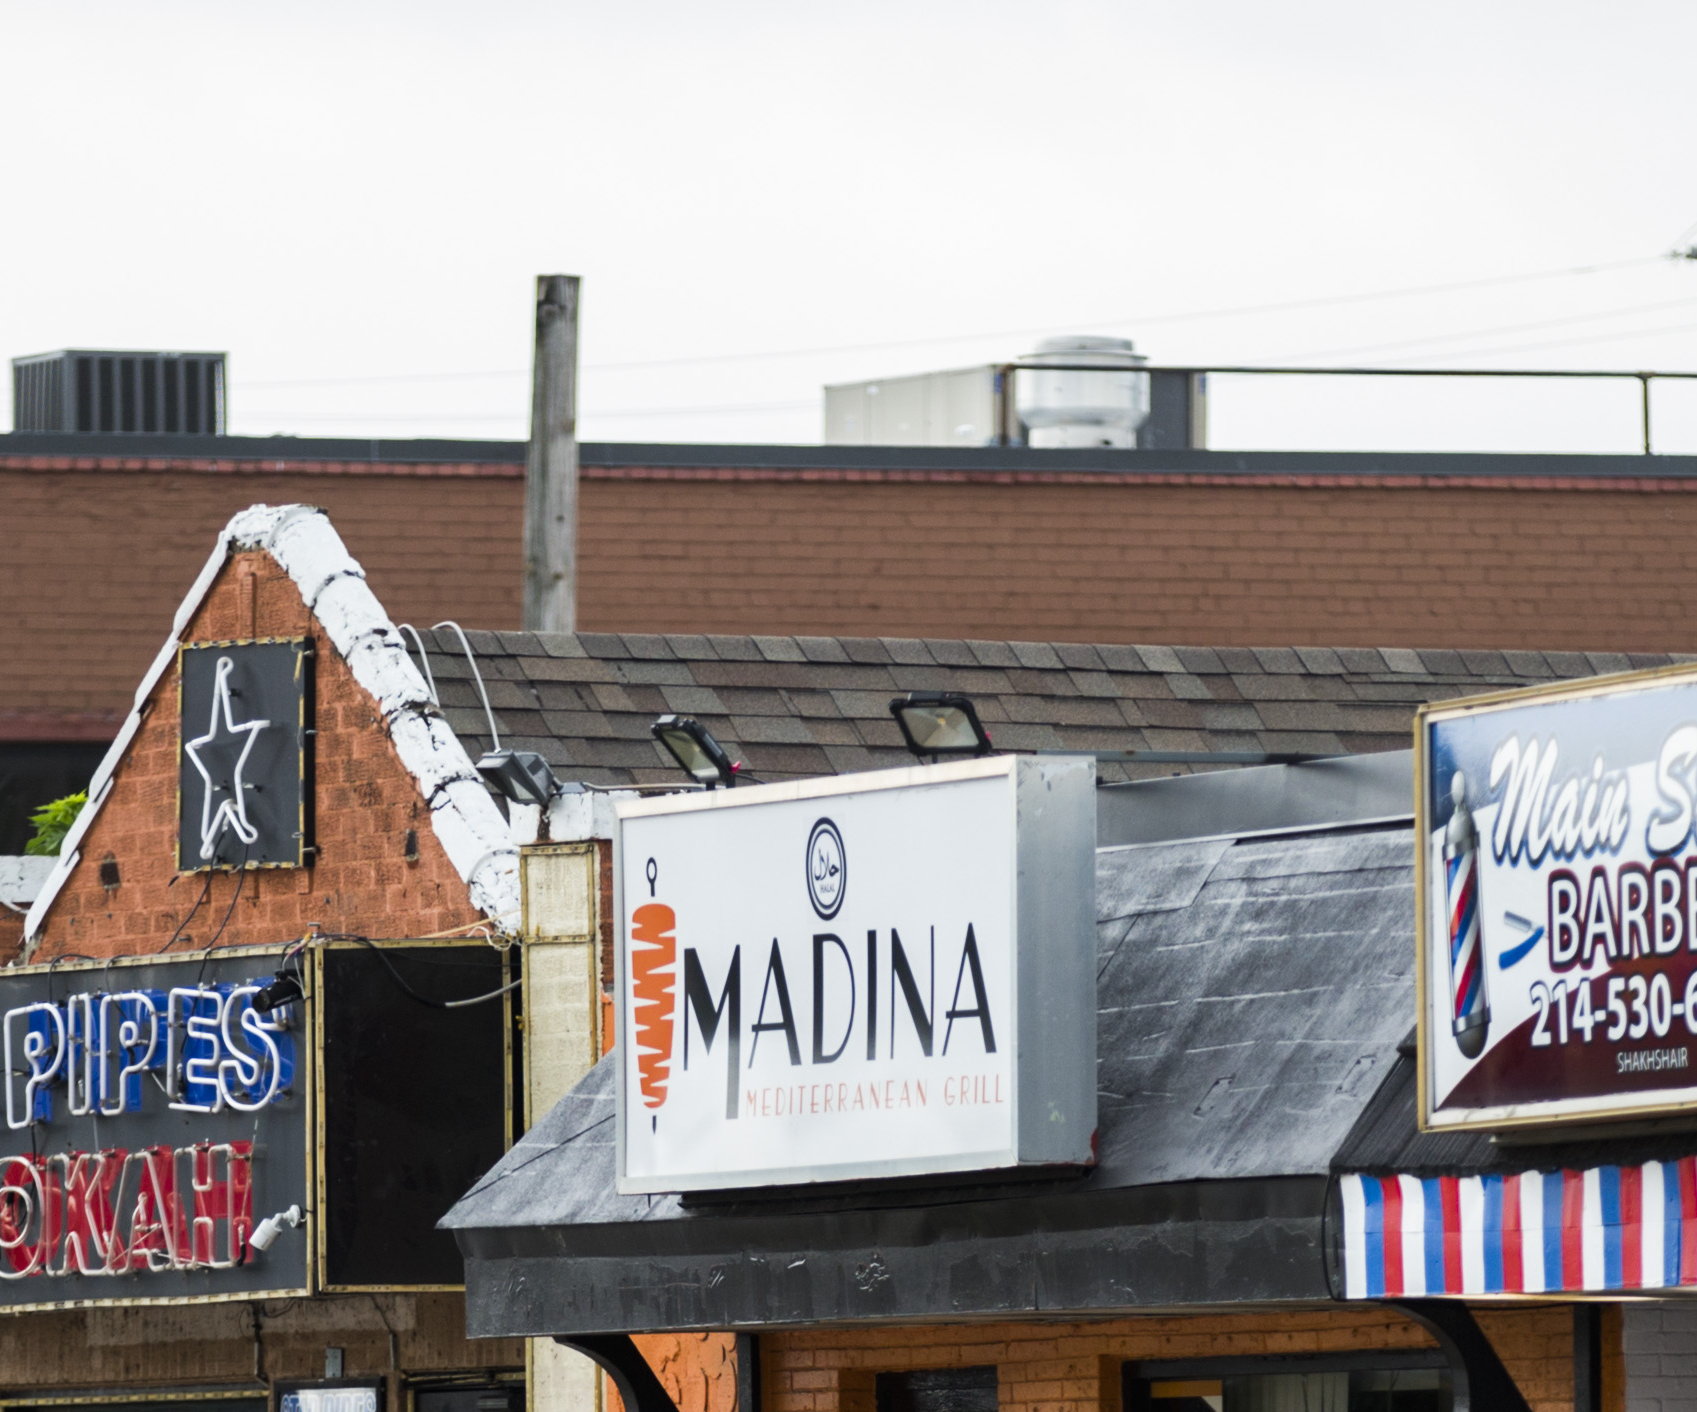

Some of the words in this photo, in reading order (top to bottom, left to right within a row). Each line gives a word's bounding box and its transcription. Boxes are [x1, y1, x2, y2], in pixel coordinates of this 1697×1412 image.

[1490, 735, 1630, 866] Main
[4, 982, 293, 1130] PIPES
[683, 922, 996, 1120] MADINA
[1617, 1047, 1689, 1074] SHAKHSHAIR
[746, 1080, 928, 1118] MEDITERRANEAN
[943, 1074, 1004, 1107] GRILL
